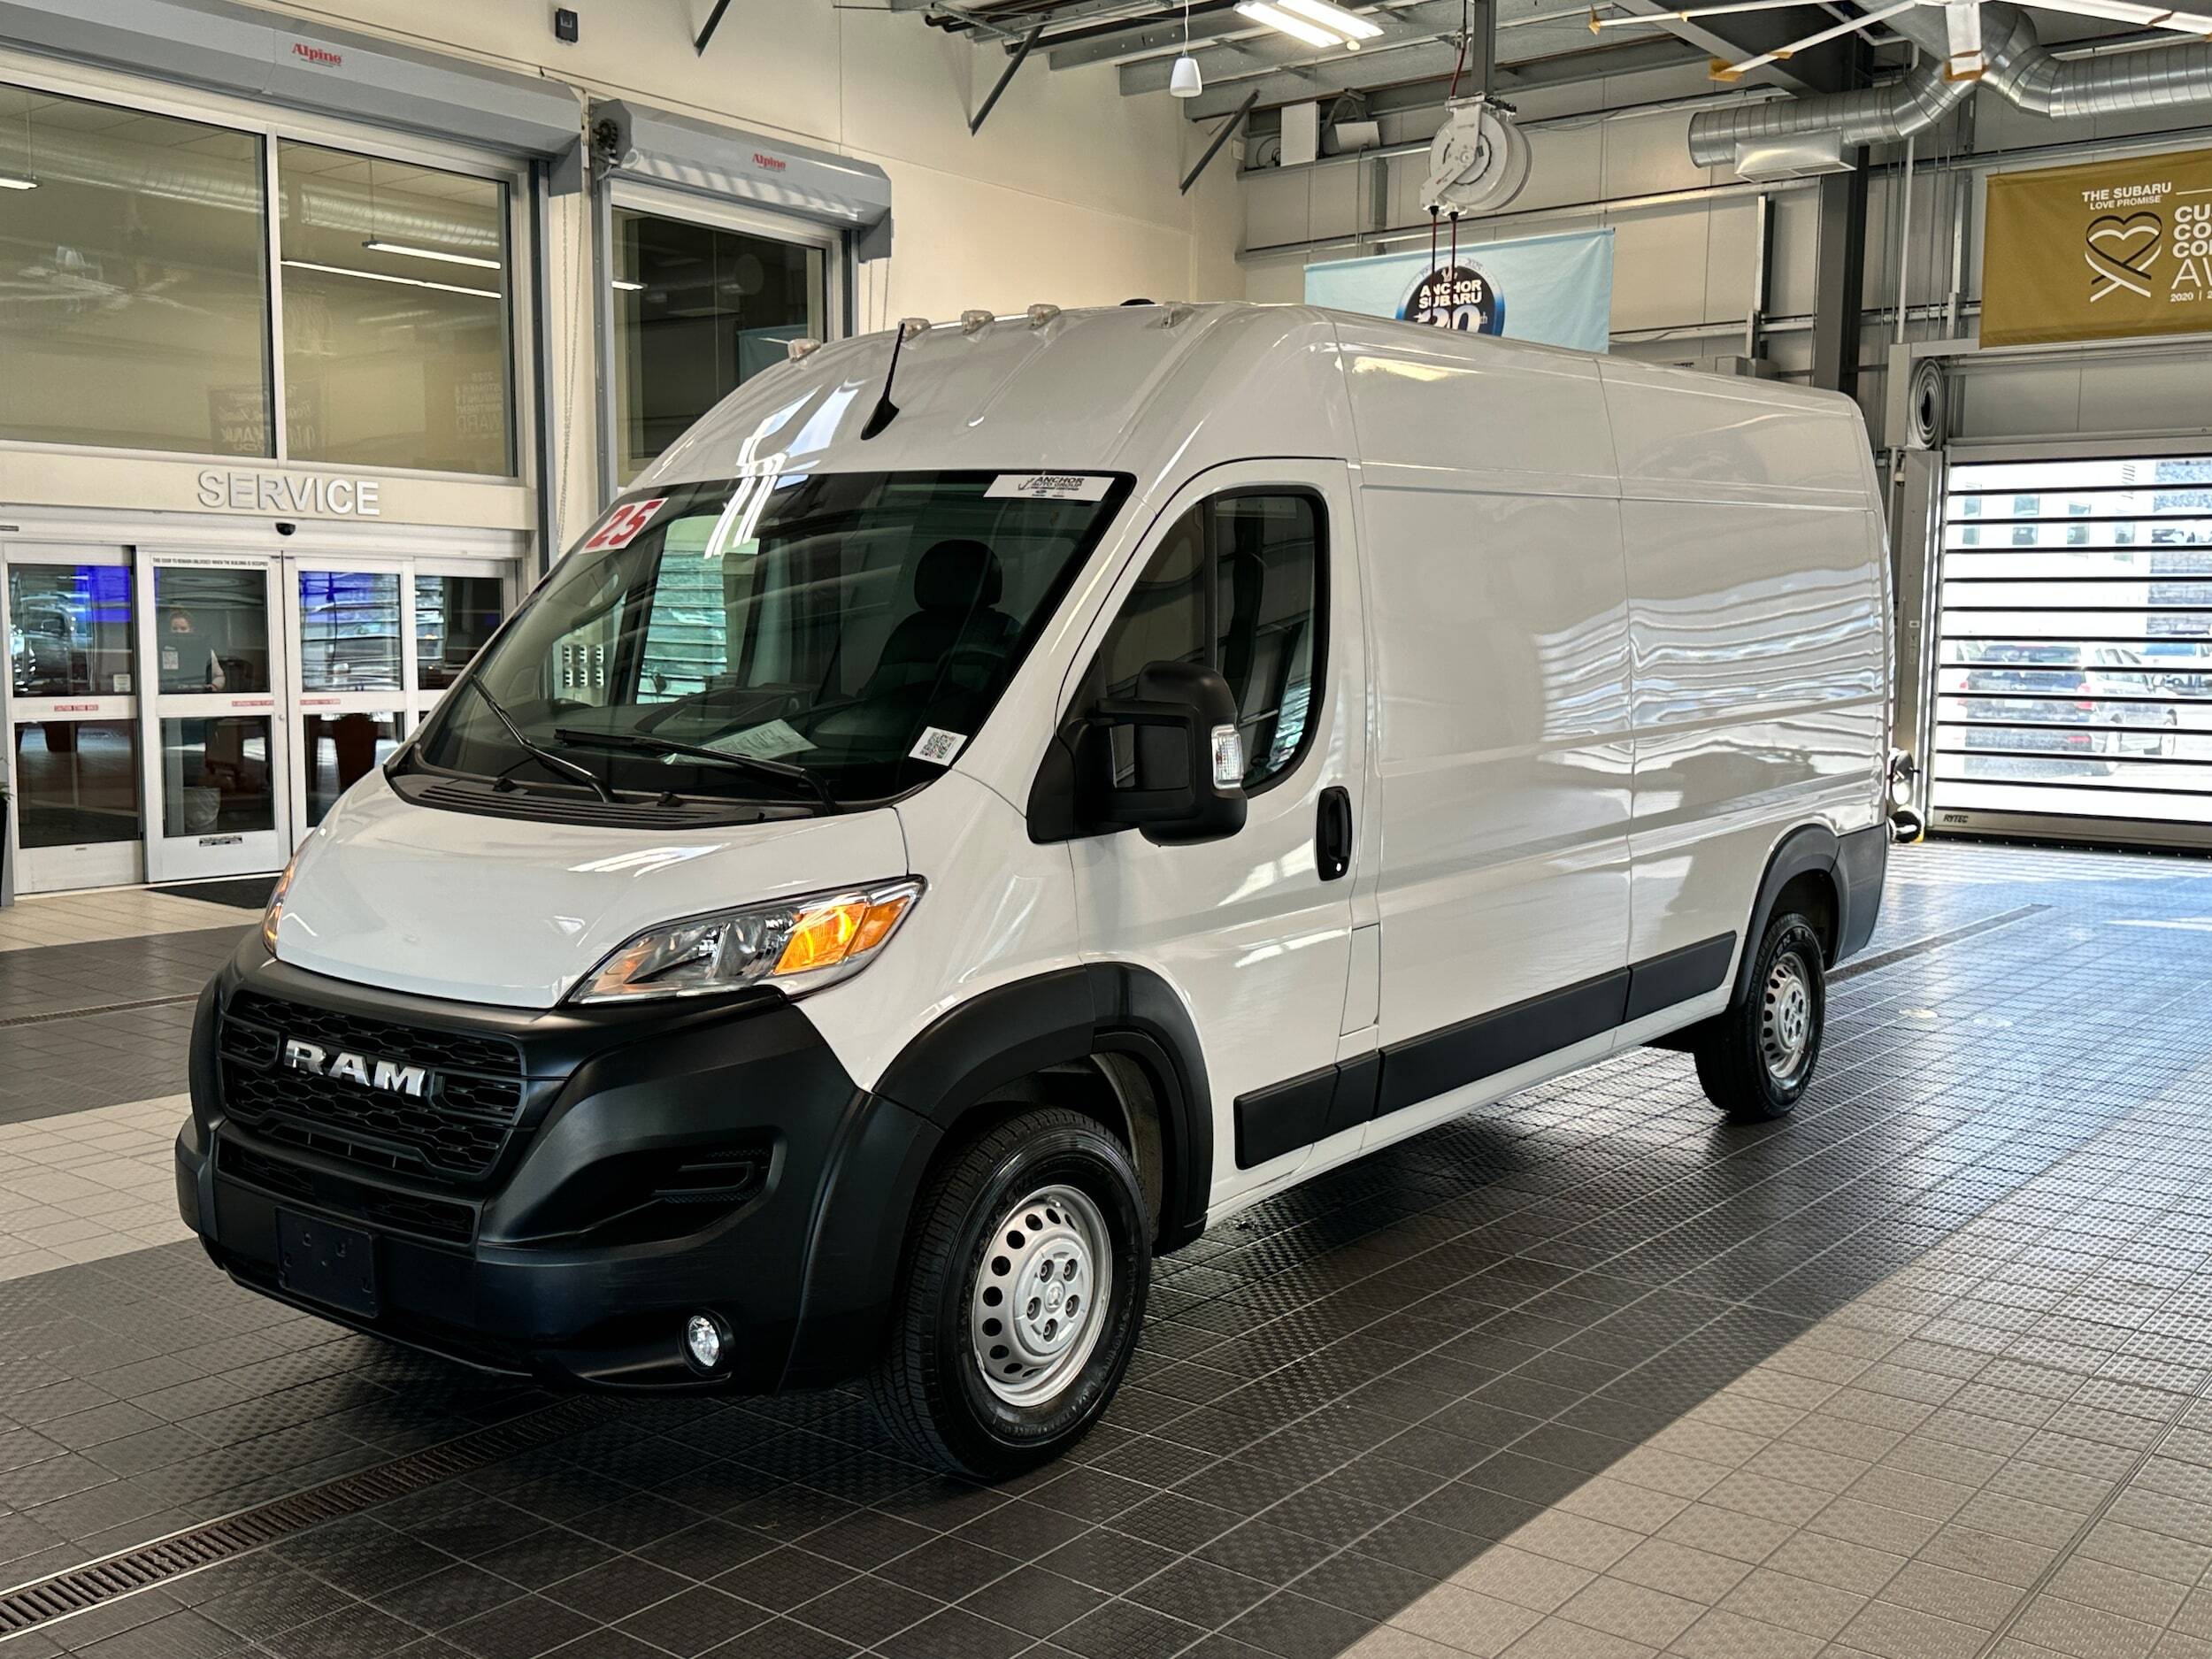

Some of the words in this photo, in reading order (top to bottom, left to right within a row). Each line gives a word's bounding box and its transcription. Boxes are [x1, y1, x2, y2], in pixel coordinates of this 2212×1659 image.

[292, 43, 342, 64] Alpine
[752, 153, 787, 170] Alpine
[2082, 189, 2110, 203] THE
[2113, 181, 2172, 199] SUBARU
[2090, 200, 2116, 211] LOVE
[2116, 195, 2162, 207] PROMISE
[2174, 204, 2212, 223] CU
[2172, 239, 2212, 258] CO
[1419, 280, 1482, 297] ANCHOR
[2170, 292, 2194, 302] 2020
[1418, 291, 1482, 309] SUBARU
[197, 470, 380, 516] SERVICE
[585, 500, 663, 549] 25
[1943, 814, 1969, 823] RYTEC
[284, 1039, 426, 1097] RAM
